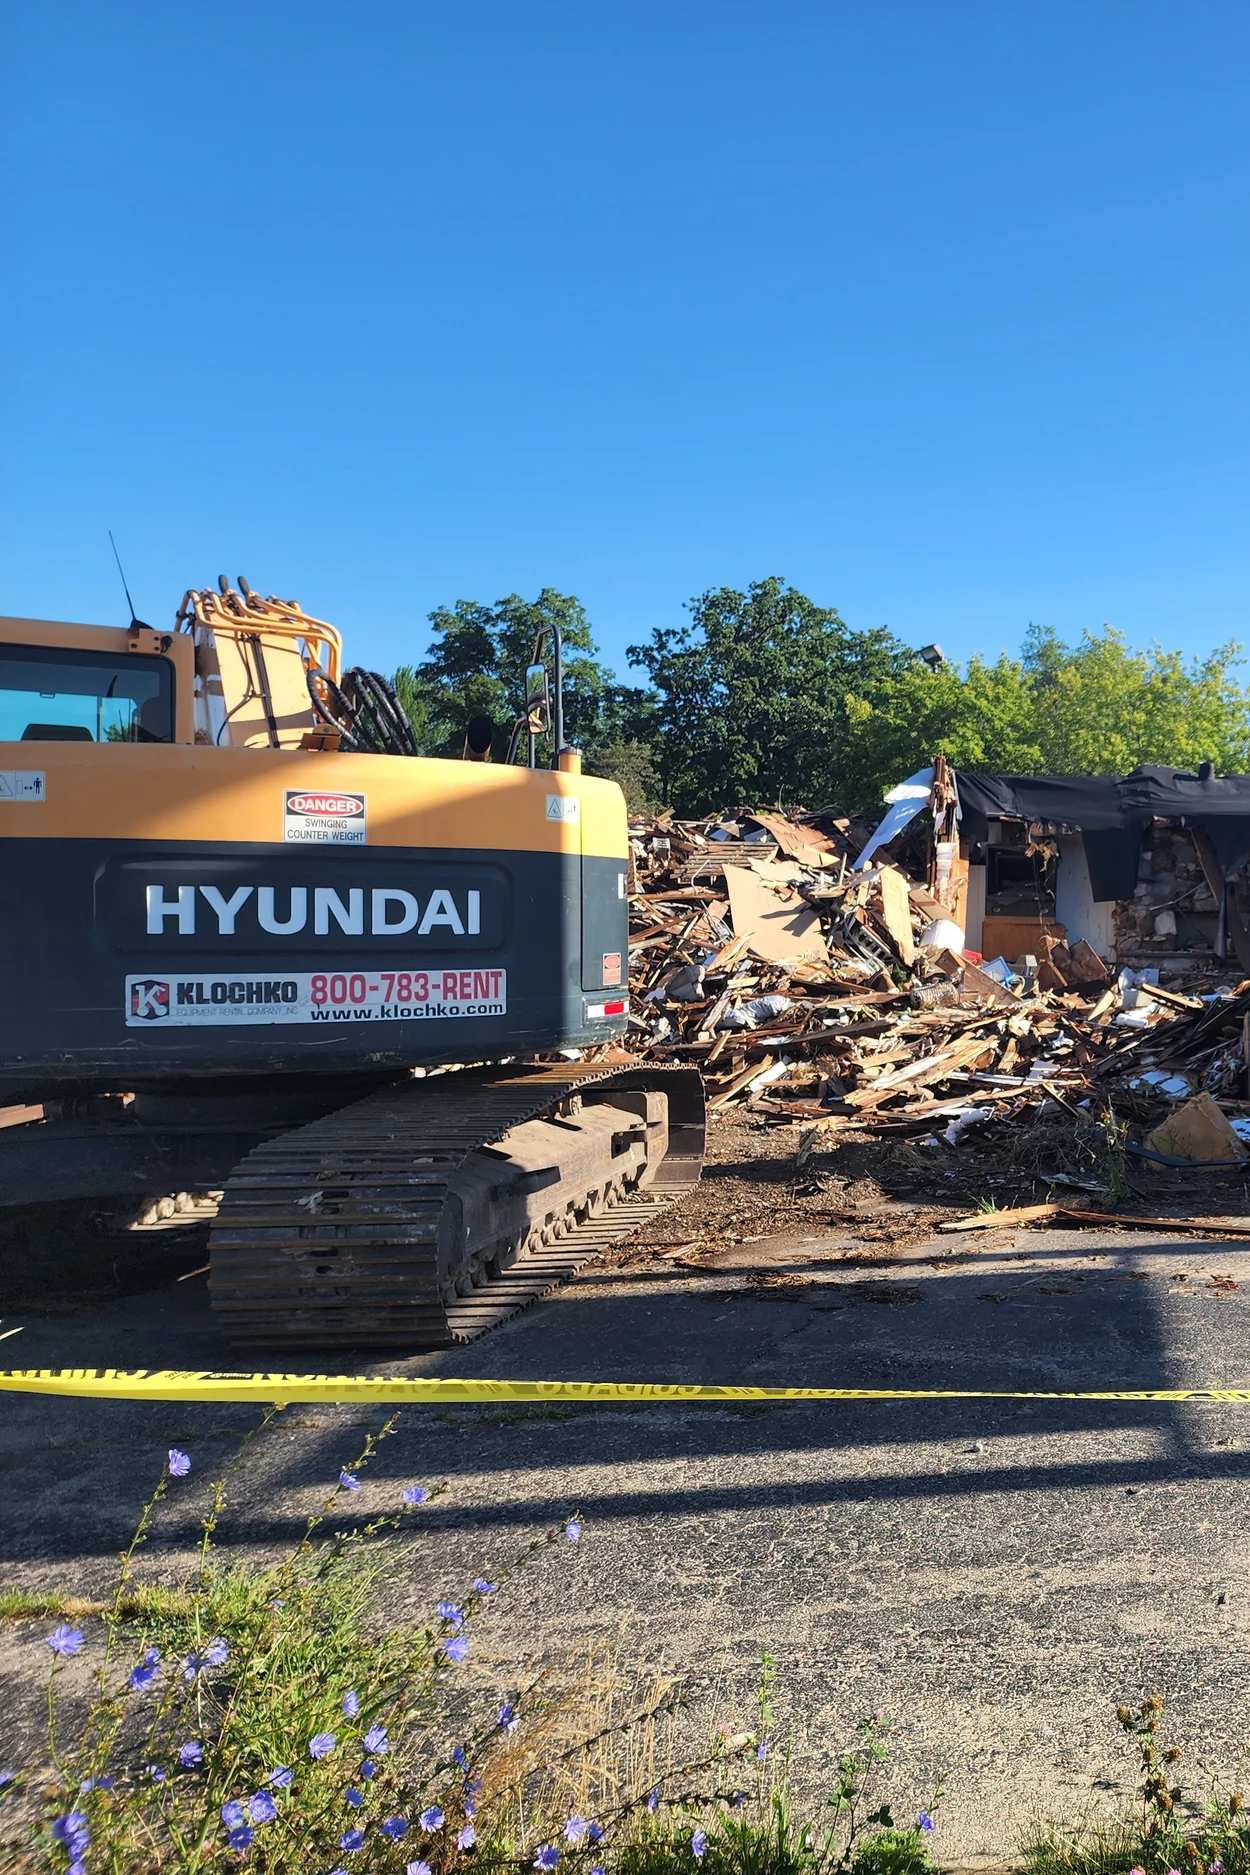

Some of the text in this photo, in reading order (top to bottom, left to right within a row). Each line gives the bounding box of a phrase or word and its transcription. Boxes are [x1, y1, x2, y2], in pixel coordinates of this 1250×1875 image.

[294, 798, 357, 813] DANGER
[305, 818, 348, 829] SWINGING
[287, 829, 364, 842] COUNTER WEIGHT
[146, 885, 481, 936] HYUNDAI
[176, 971, 503, 1005] KLOCHKO 800-783-RENT
[311, 1003, 503, 1021] www.klochko.com
